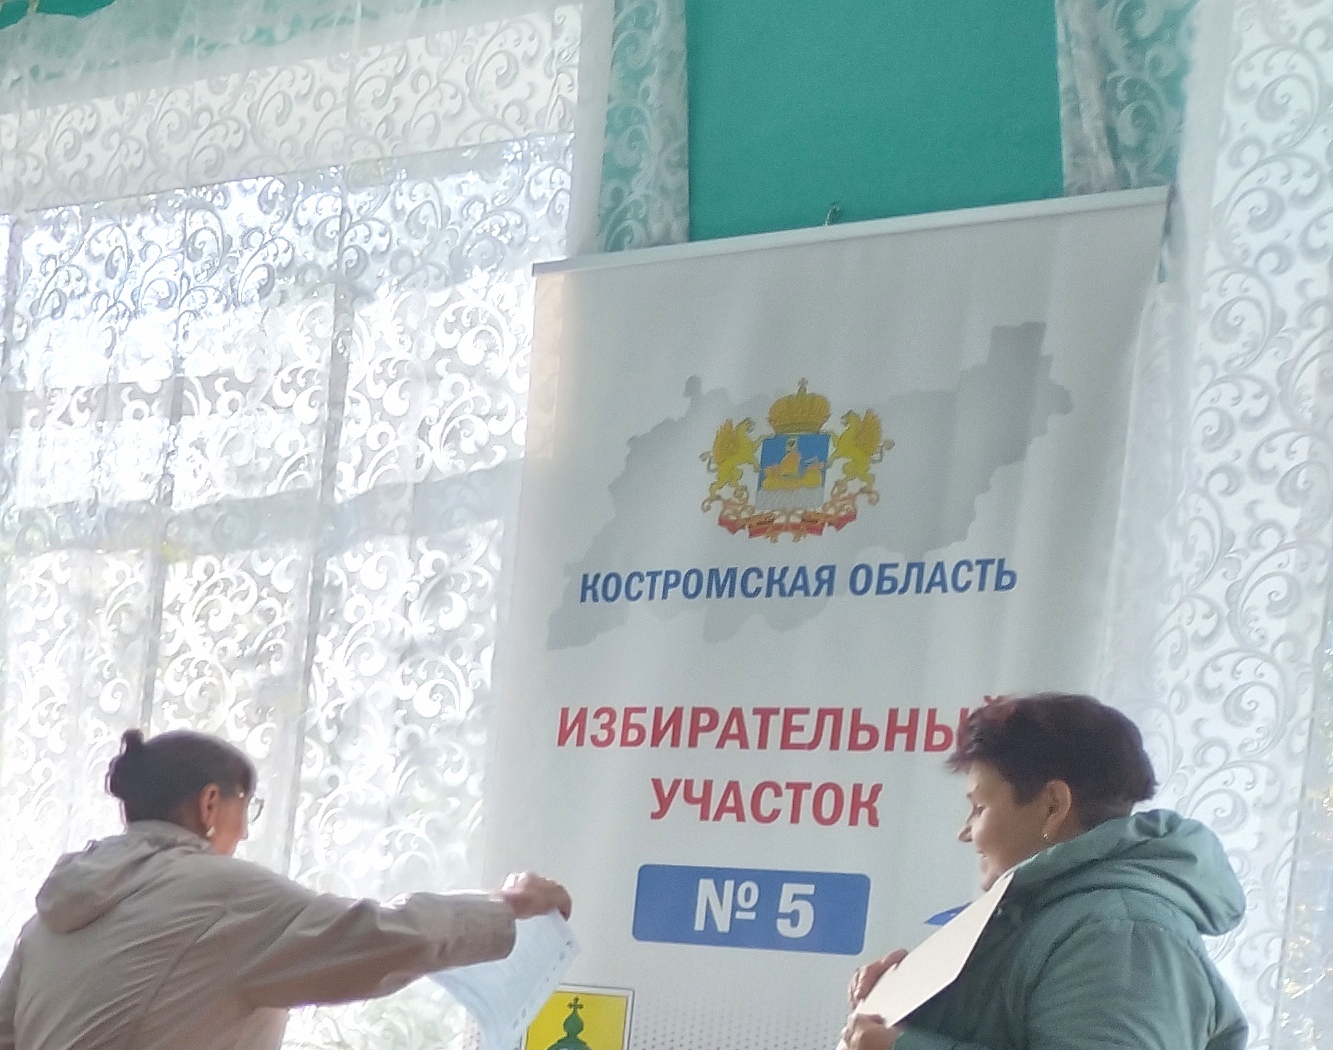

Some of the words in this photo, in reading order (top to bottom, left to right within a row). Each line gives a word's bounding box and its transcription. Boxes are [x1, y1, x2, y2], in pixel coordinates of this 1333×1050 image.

[579, 563, 836, 603] КОСТРОМСКАЯ
[848, 557, 1019, 596] ОБЛАСТЬ
[649, 777, 884, 828] УЧАСТОК
[693, 877, 759, 934] №
[776, 883, 816, 939] 5
